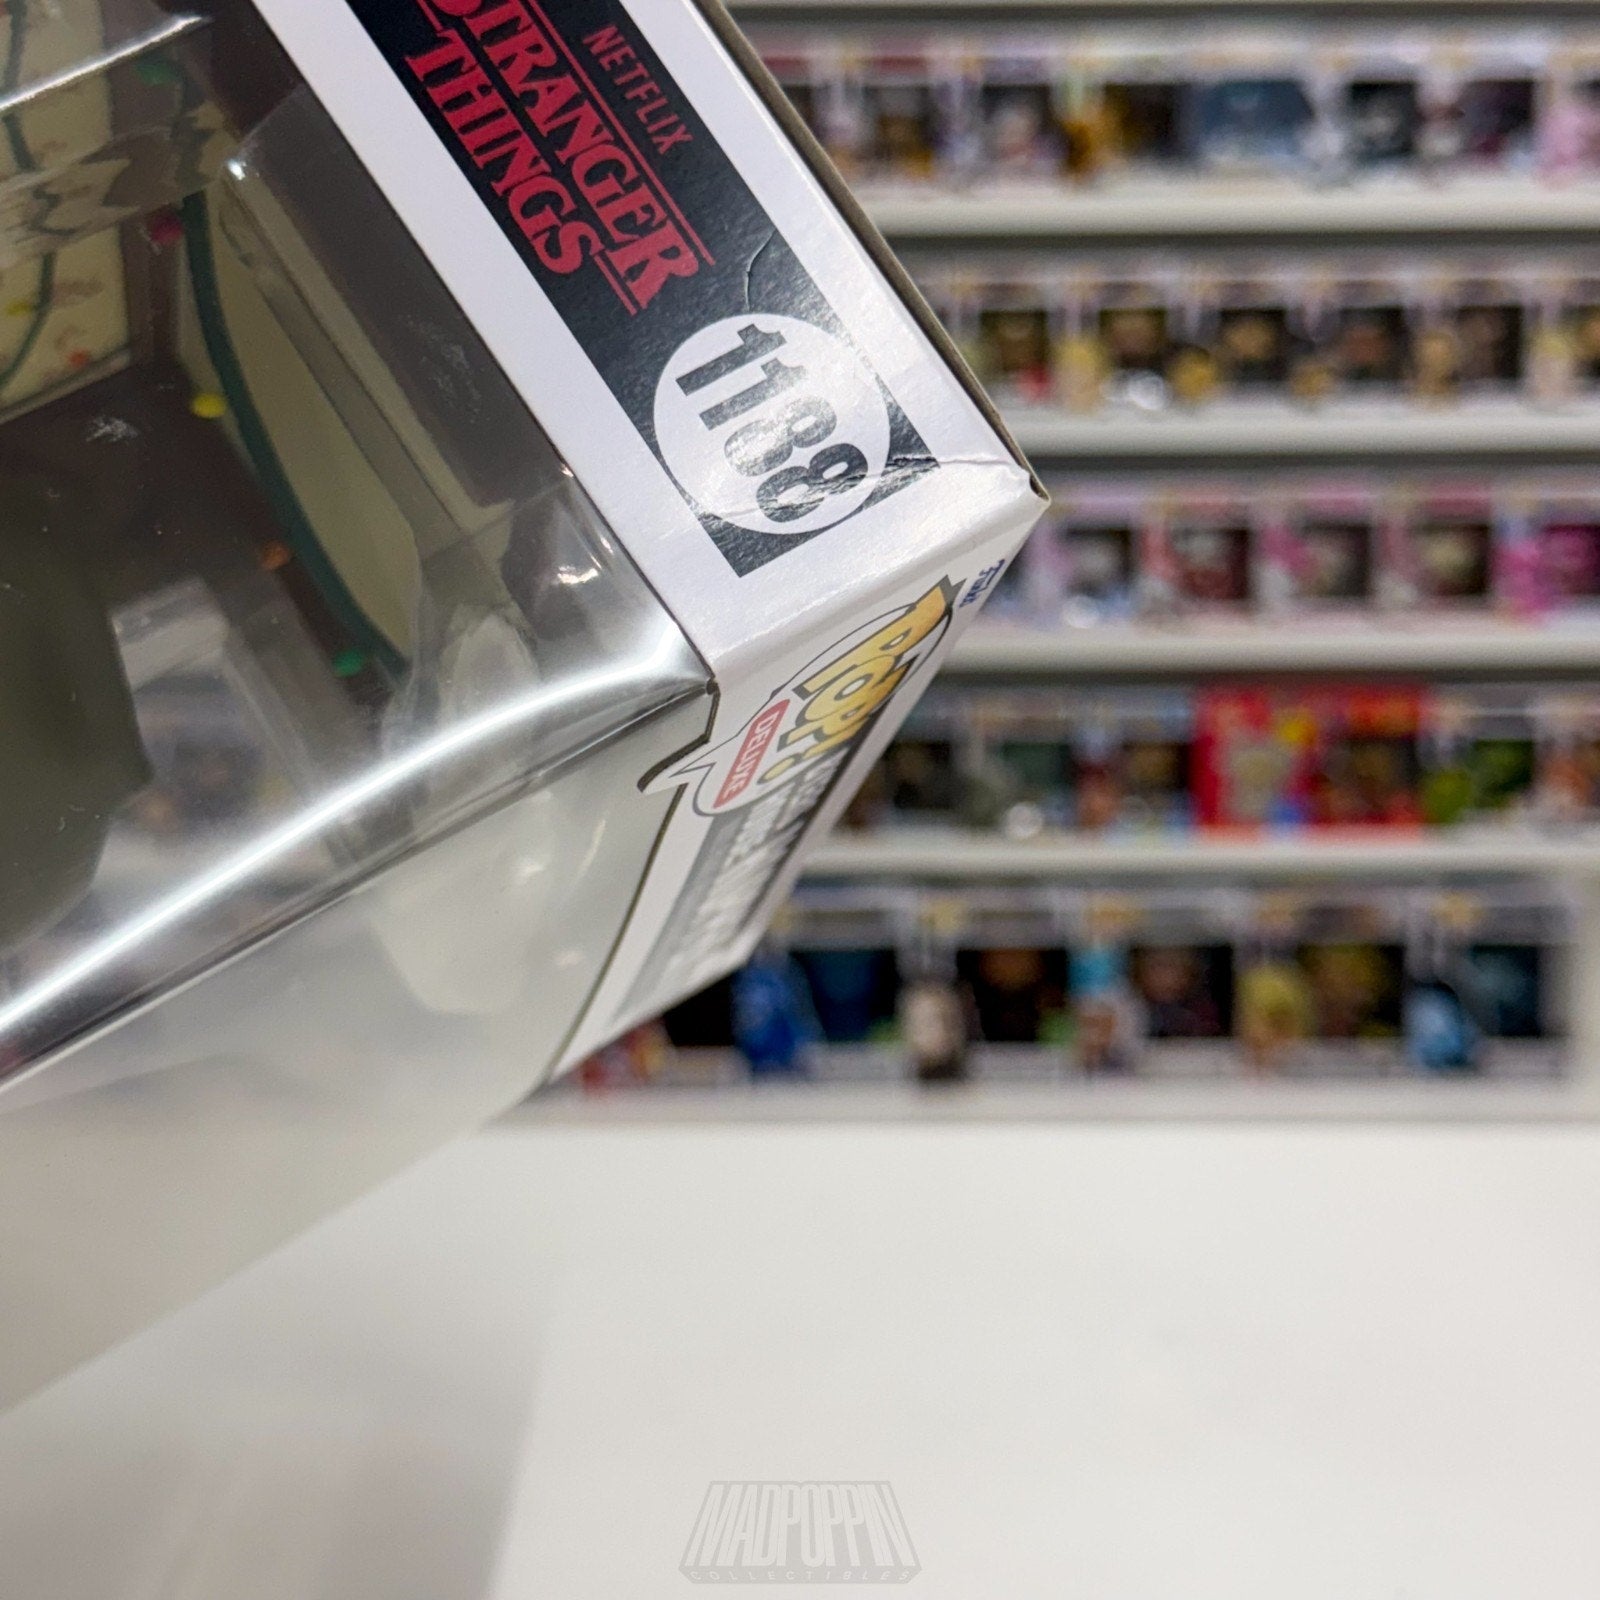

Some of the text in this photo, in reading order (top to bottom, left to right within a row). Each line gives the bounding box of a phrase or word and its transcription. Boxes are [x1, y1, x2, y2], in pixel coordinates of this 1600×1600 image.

[404, 28, 603, 274] THINGS
[583, 25, 694, 155] NETFLIX
[675, 323, 869, 523] 1188
[721, 710, 780, 800] DELUXE
[757, 574, 967, 785] POP!
